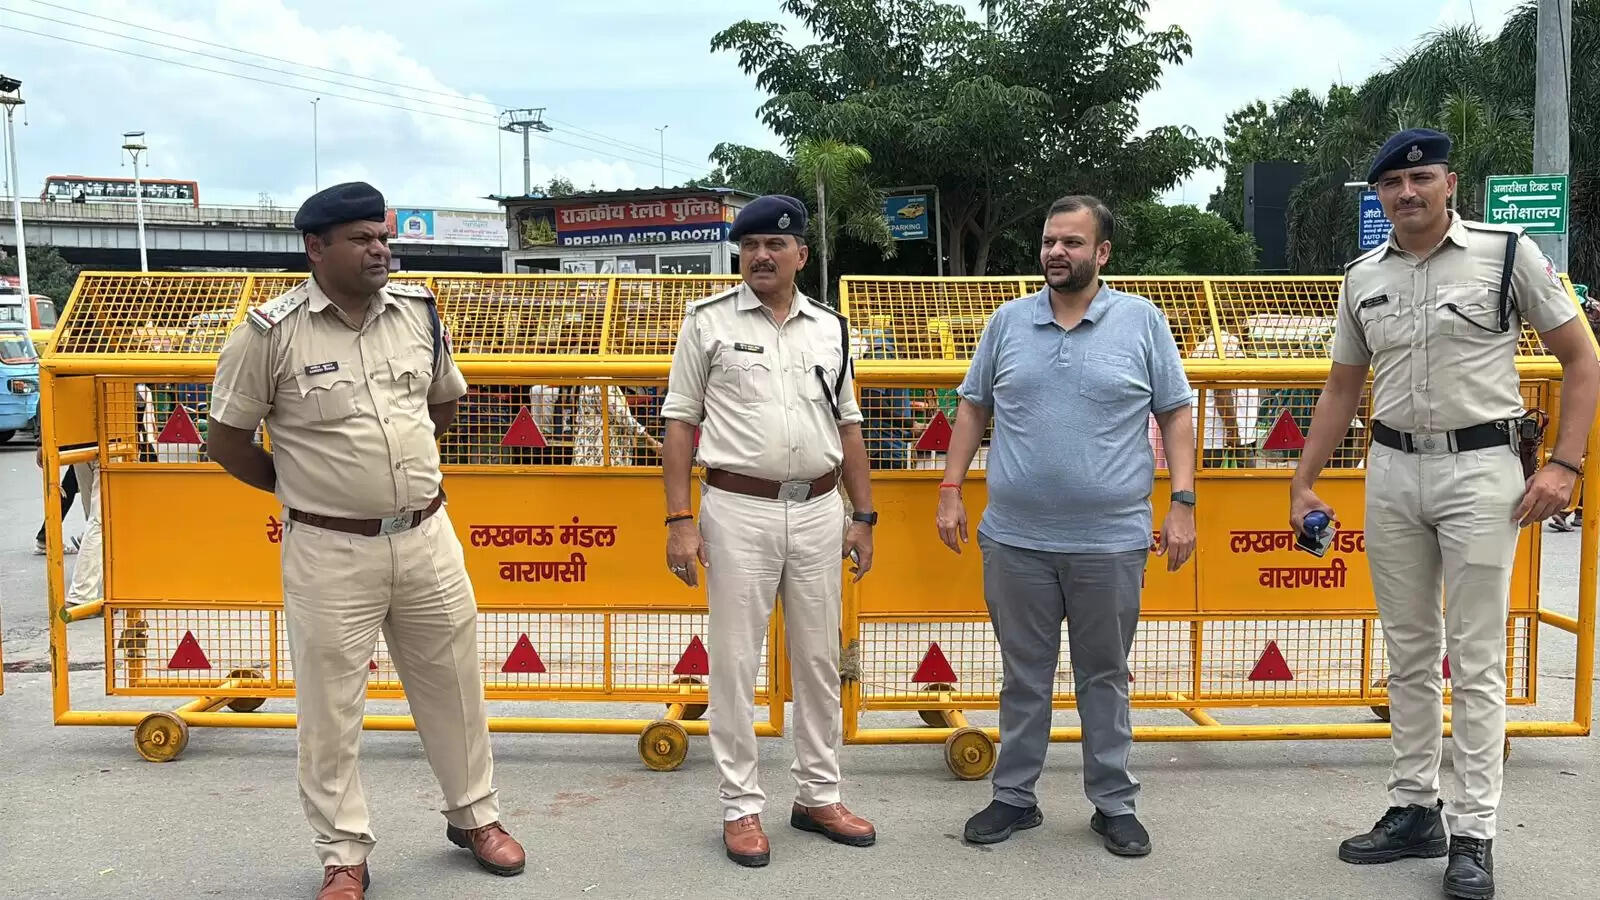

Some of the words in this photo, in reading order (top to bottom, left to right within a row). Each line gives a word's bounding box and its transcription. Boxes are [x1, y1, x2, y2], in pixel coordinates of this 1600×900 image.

[1492, 181, 1528, 193] अनारक्षित
[1529, 180, 1550, 192] टिकट
[1551, 182, 1562, 192] घर
[561, 203, 625, 224] राजकीय
[630, 200, 666, 219] रेलवे
[671, 198, 721, 222] पुलिस
[1492, 203, 1562, 220] प्रतीक्षालय
[628, 231, 667, 244] AUTO
[671, 228, 721, 242] BOOTH
[891, 223, 921, 231] PARKING
[470, 524, 554, 548] लखनऊ
[559, 516, 618, 548] मंडल
[1230, 530, 1303, 553] लखन
[499, 553, 587, 583] वाराणसी
[1258, 558, 1347, 589] वाराणसी
